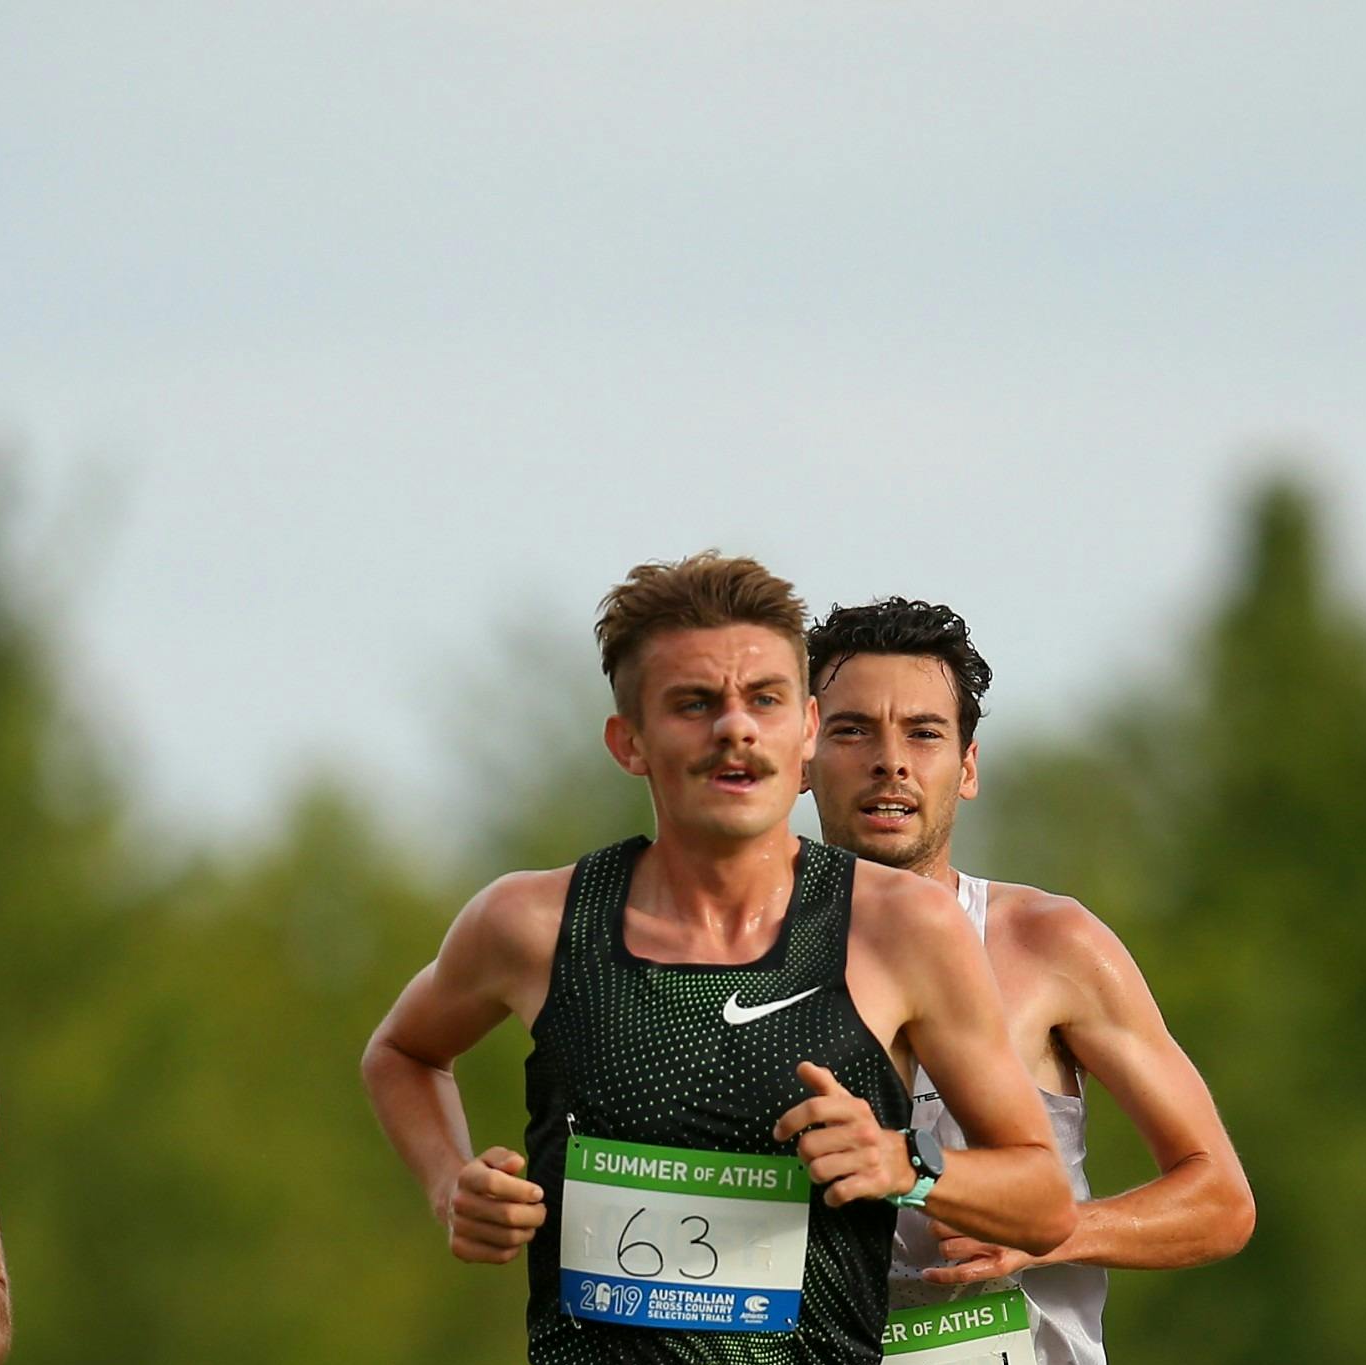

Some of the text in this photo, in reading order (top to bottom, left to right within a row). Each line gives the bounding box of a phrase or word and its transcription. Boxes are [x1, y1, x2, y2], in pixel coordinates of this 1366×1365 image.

[593, 1152, 777, 1188] SUMMER OF ATHS
[617, 1207, 718, 1280] 63
[579, 1279, 643, 1317] 2019
[648, 1288, 735, 1306] AUSTRALIAN
[648, 1301, 733, 1315] CROSS COUNTRY
[647, 1310, 699, 1322] SELECTION
[700, 1313, 732, 1323] TRIALS
[912, 1321, 933, 1337] OF
[937, 1306, 994, 1335] ATHS
